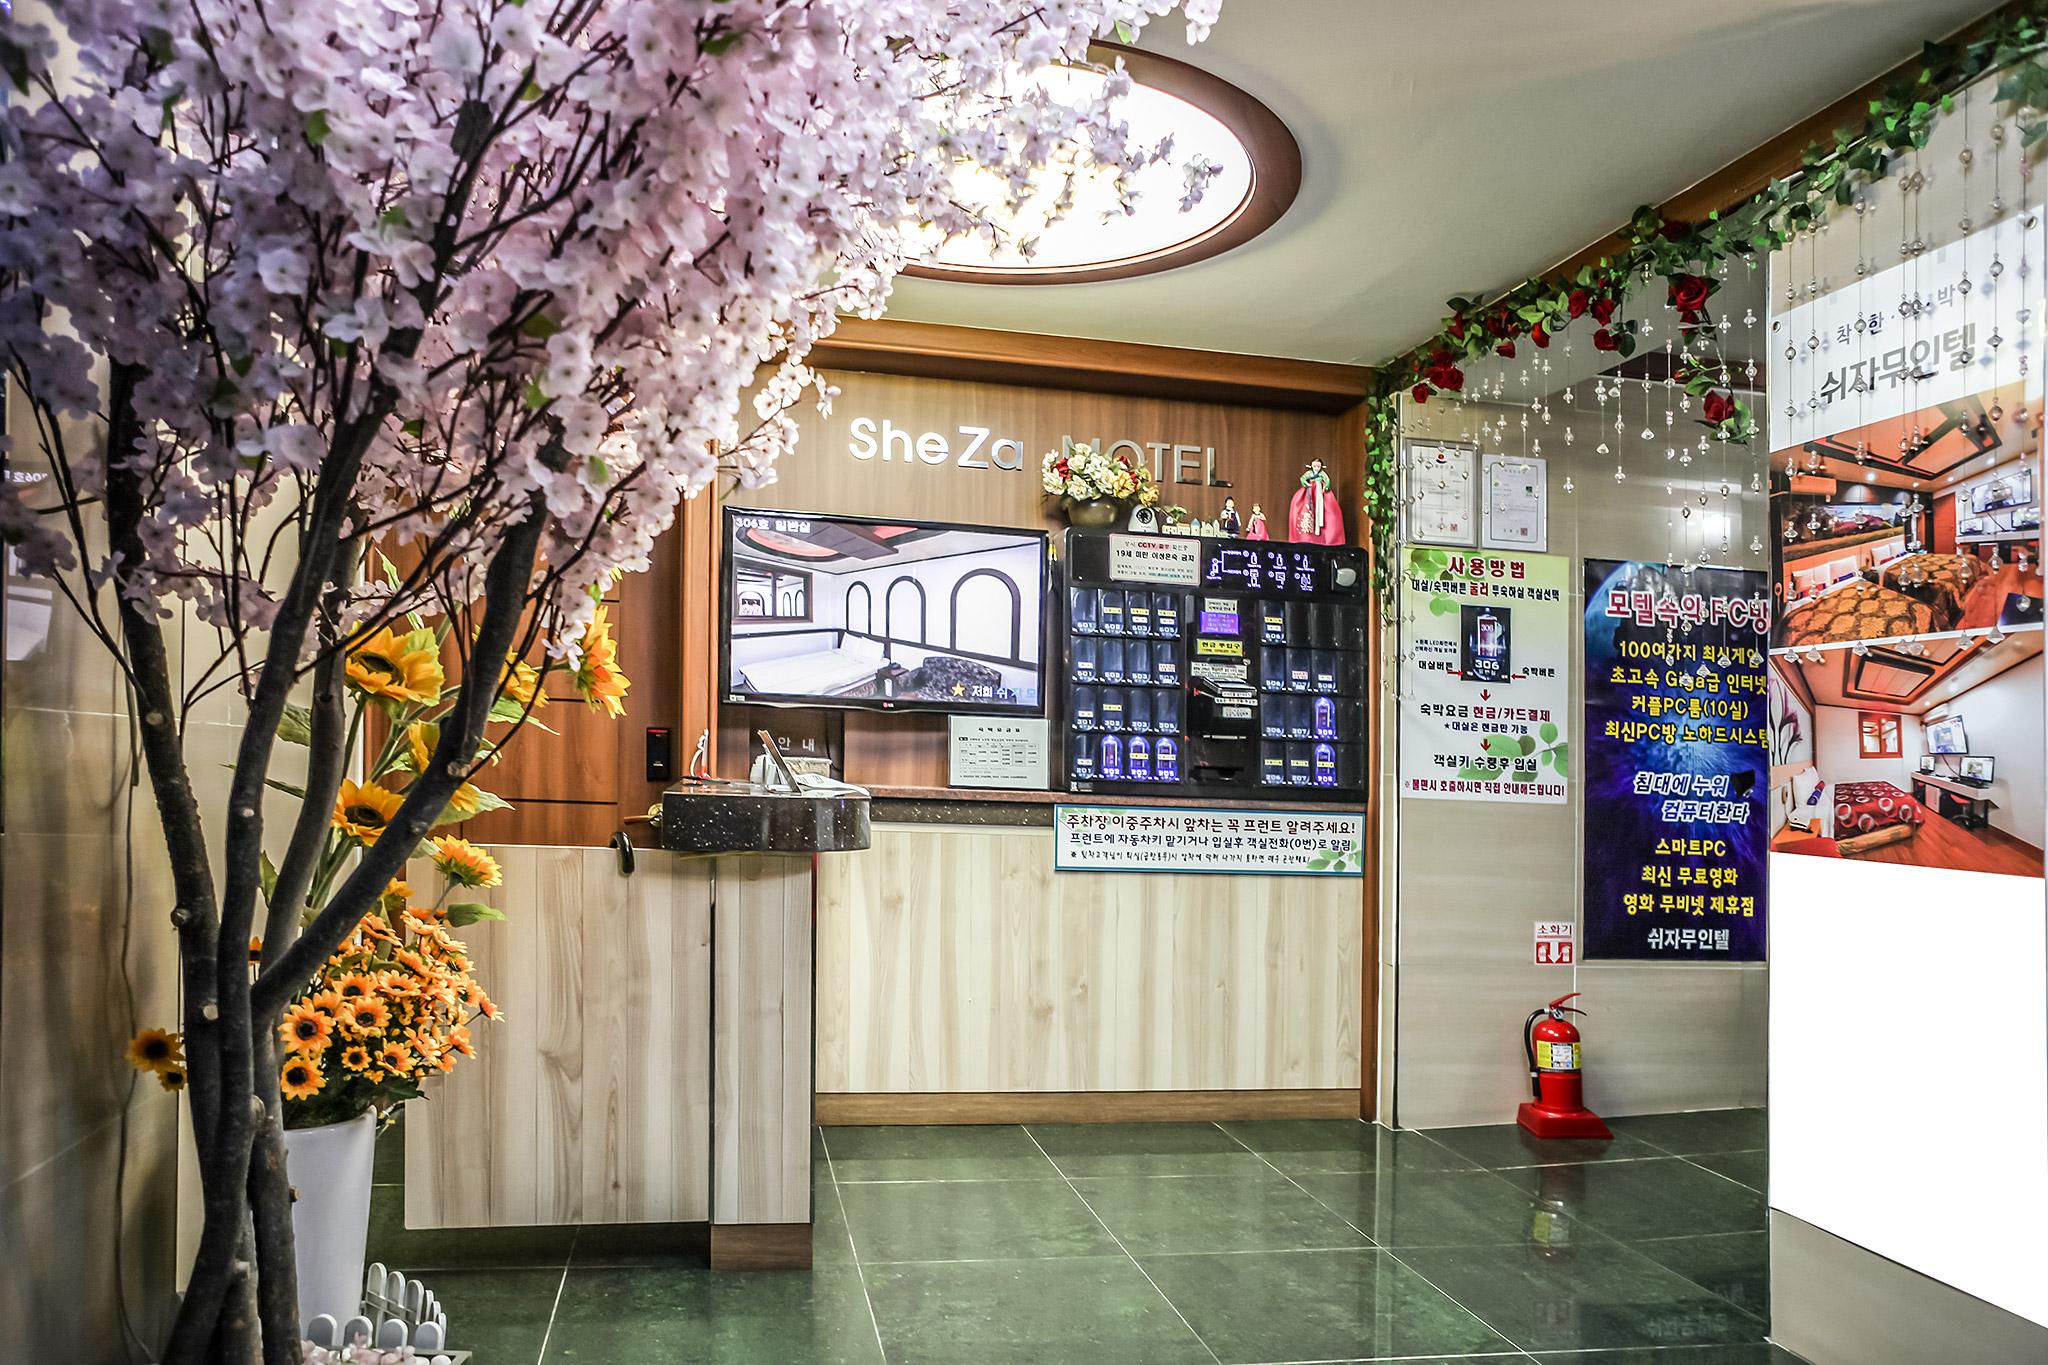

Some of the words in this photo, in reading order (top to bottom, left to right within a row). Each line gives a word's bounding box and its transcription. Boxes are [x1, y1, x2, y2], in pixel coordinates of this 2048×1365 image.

[1137, 541, 1157, 549] CCTV
[1116, 549, 1133, 558] 19세
[1181, 554, 1195, 562] 금지
[1448, 556, 1525, 579] 사용방법
[1411, 579, 1467, 595] 대실/숙박버튼
[1469, 581, 1489, 597] 눌러
[1491, 584, 1525, 600] 투숙하실
[1527, 587, 1560, 602] 객실선택
[1605, 590, 1703, 628] 모텔속의
[1418, 660, 1455, 671] 대실버튼
[1522, 666, 1556, 678] 숙박버튼
[1475, 659, 1500, 670] 306
[1610, 665, 1660, 689] 초고속
[1726, 674, 1768, 695] 인터넷
[971, 685, 993, 698] 저희
[1420, 703, 1469, 718] 숙박요금
[1473, 706, 1551, 722] 현금/카드결제
[1631, 695, 1749, 721] 커플PC룸(10실)
[1452, 721, 1480, 732] 대실은
[1481, 722, 1509, 734] 현금만
[1511, 723, 1529, 735] 가능
[1604, 720, 1677, 745] 최신PC방
[1683, 725, 1769, 749] 노하드시스템
[1433, 754, 1470, 768] 객실키
[1474, 756, 1510, 770] 수령후
[1514, 758, 1538, 772] 입실
[1440, 780, 1482, 793] 호출하시면
[1484, 781, 1501, 794] 직접
[1503, 782, 1565, 797] 안내해드립니다!
[1633, 771, 1691, 796] 침대에
[1691, 774, 1730, 797] 누워
[1661, 800, 1751, 825] 컴퓨터한다
[1066, 814, 1109, 830] 주차장
[1112, 815, 1180, 831] 이중주차시
[1183, 817, 1224, 832] 앞차는
[1227, 819, 1241, 833] 꼭
[1243, 819, 1283, 834] 프런트
[1286, 820, 1356, 835] 알려주세요!
[1070, 833, 1115, 845] 프런트에
[1118, 834, 1162, 846] 자동차키
[1165, 835, 1209, 847] 맡기거나
[1212, 836, 1244, 849] 입실후
[1247, 837, 1328, 851] 객실전화(0번)로
[1330, 839, 1352, 852] 알림
[1655, 838, 1727, 858] 스마트PC
[1641, 865, 1672, 887] 최신
[1677, 867, 1739, 888] 무료영화
[1623, 894, 1655, 915] 영화
[1659, 894, 1705, 916] 무비넷
[1709, 895, 1755, 917] 제휴점
[1537, 925, 1573, 936] 소화기
[1647, 927, 1730, 950] 쉬자무인텔
